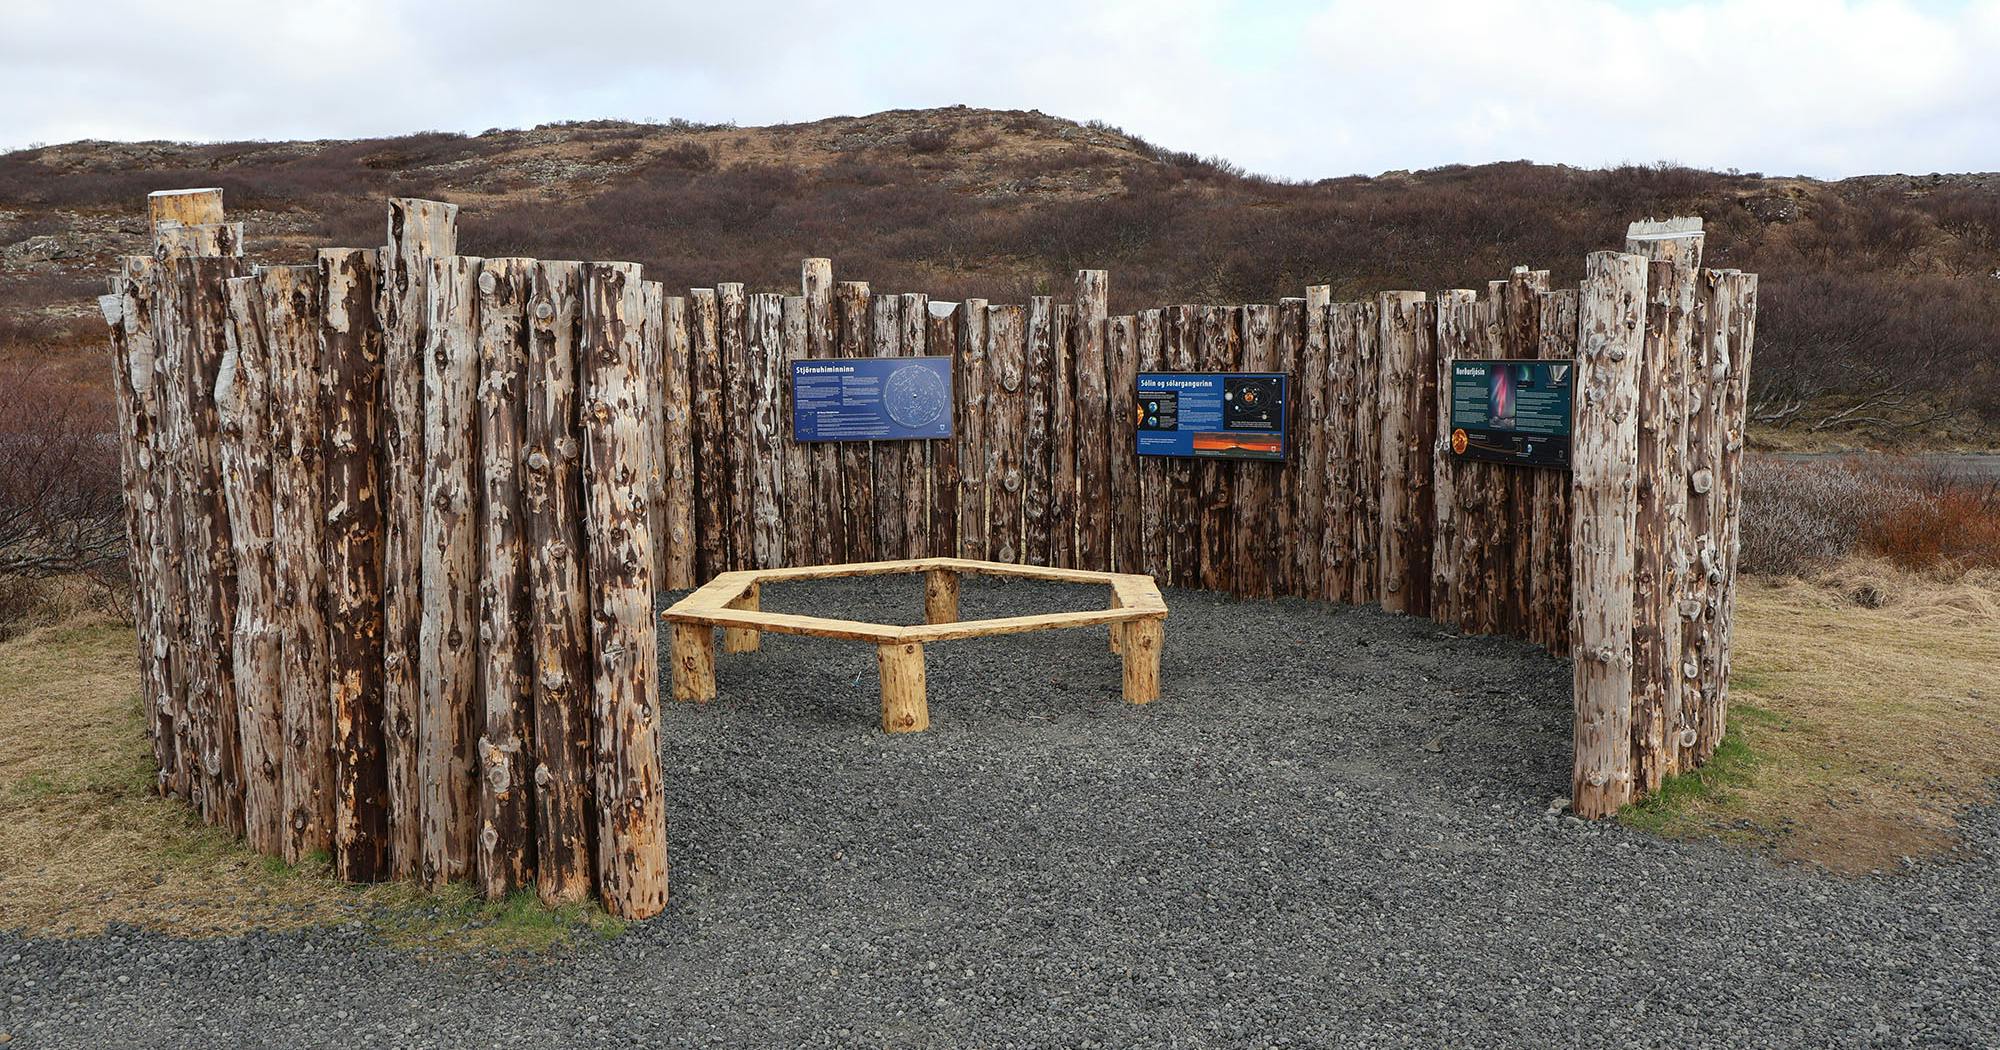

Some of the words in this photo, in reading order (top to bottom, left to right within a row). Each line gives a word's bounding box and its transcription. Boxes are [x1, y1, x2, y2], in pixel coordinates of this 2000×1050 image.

[796, 366, 855, 375] Stjörnuhiminninn
[1141, 379, 1156, 387] Sólin
[1157, 381, 1165, 389] og
[1166, 379, 1213, 389] sólargangurinn
